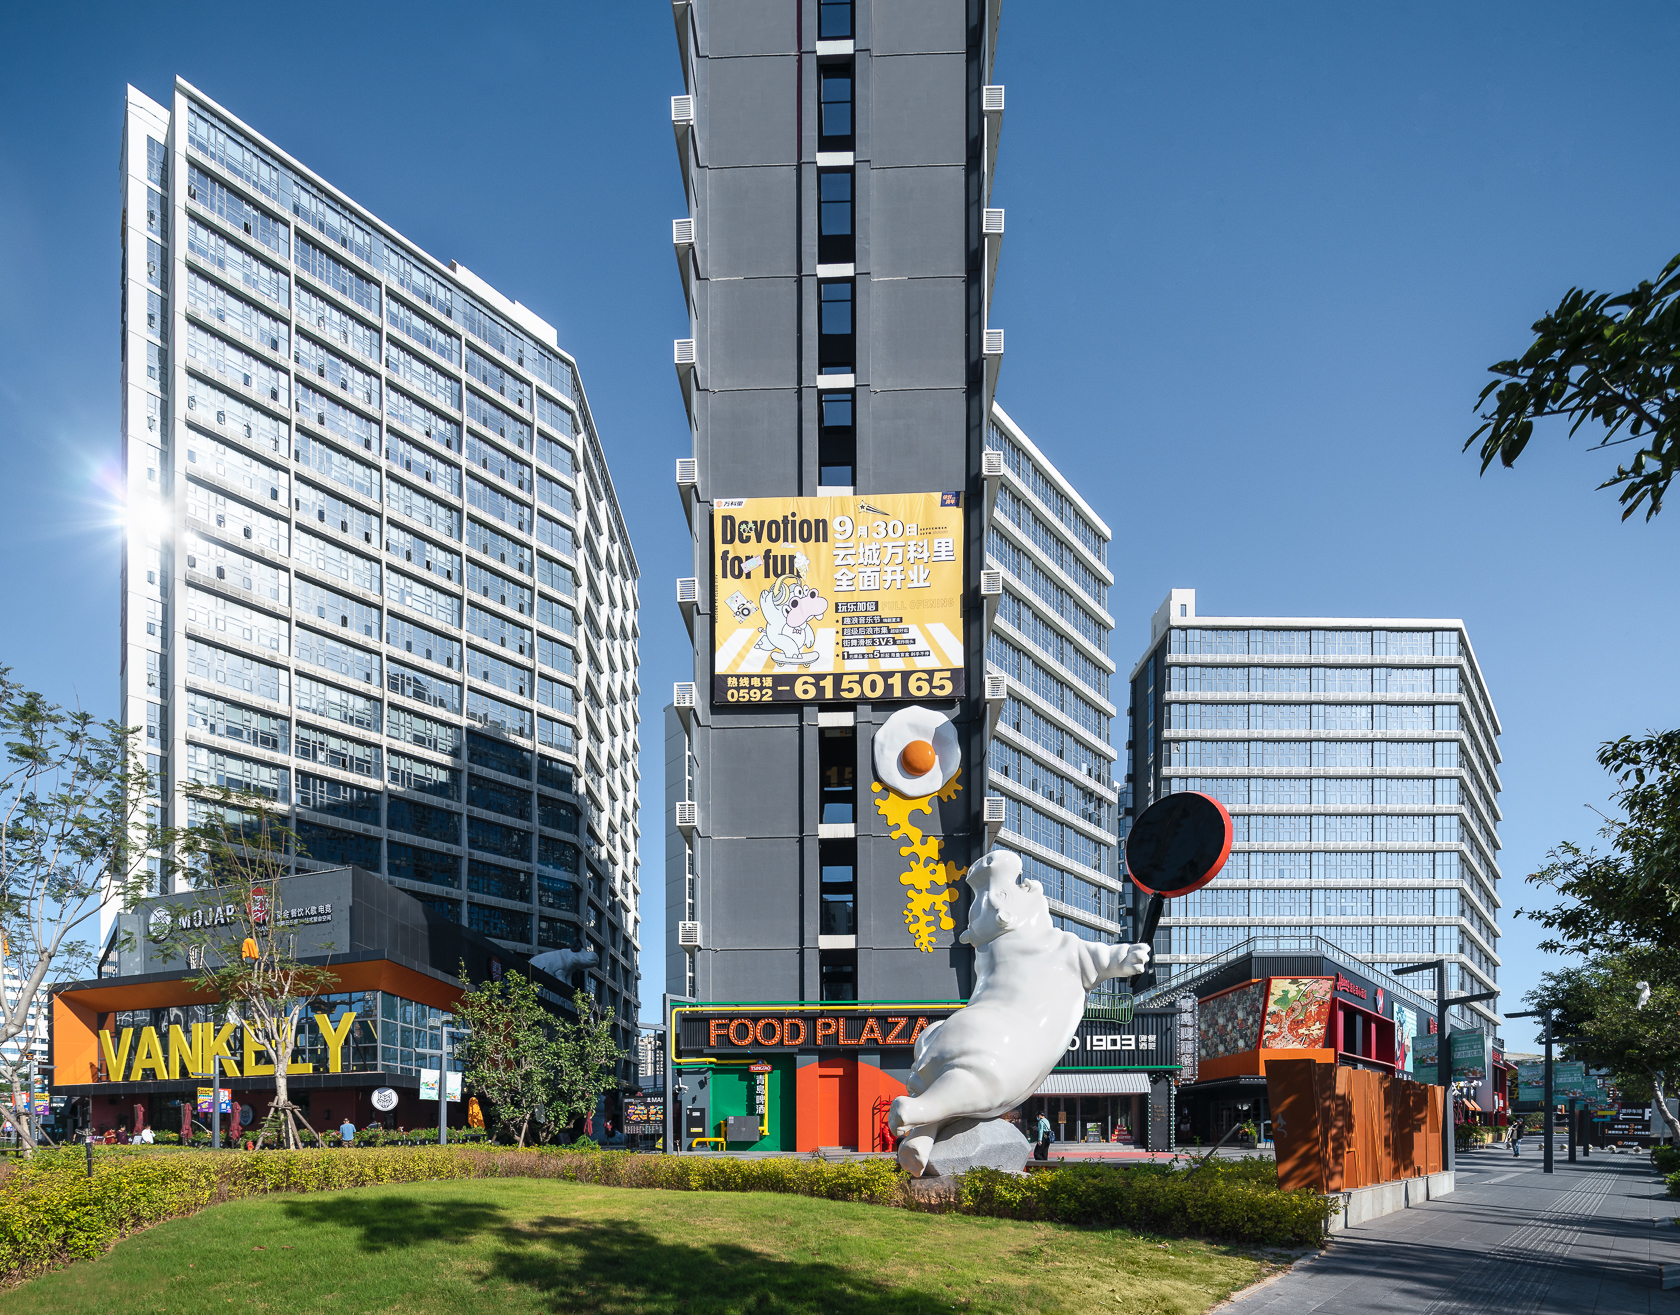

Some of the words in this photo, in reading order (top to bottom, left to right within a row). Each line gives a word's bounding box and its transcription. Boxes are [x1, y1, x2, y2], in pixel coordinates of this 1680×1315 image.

[721, 511, 829, 545] Devotion
[833, 537, 956, 567] 云城万科里
[833, 564, 931, 592] 全面开业
[837, 601, 876, 613] 玩乐加倍
[909, 598, 955, 610] OPENING
[727, 676, 773, 687] 热线电话
[727, 688, 773, 702] 0592
[709, 1017, 807, 1046] FOOD
[1086, 1034, 1136, 1051] 1903
[756, 1074, 766, 1115] 青岛啤酒
